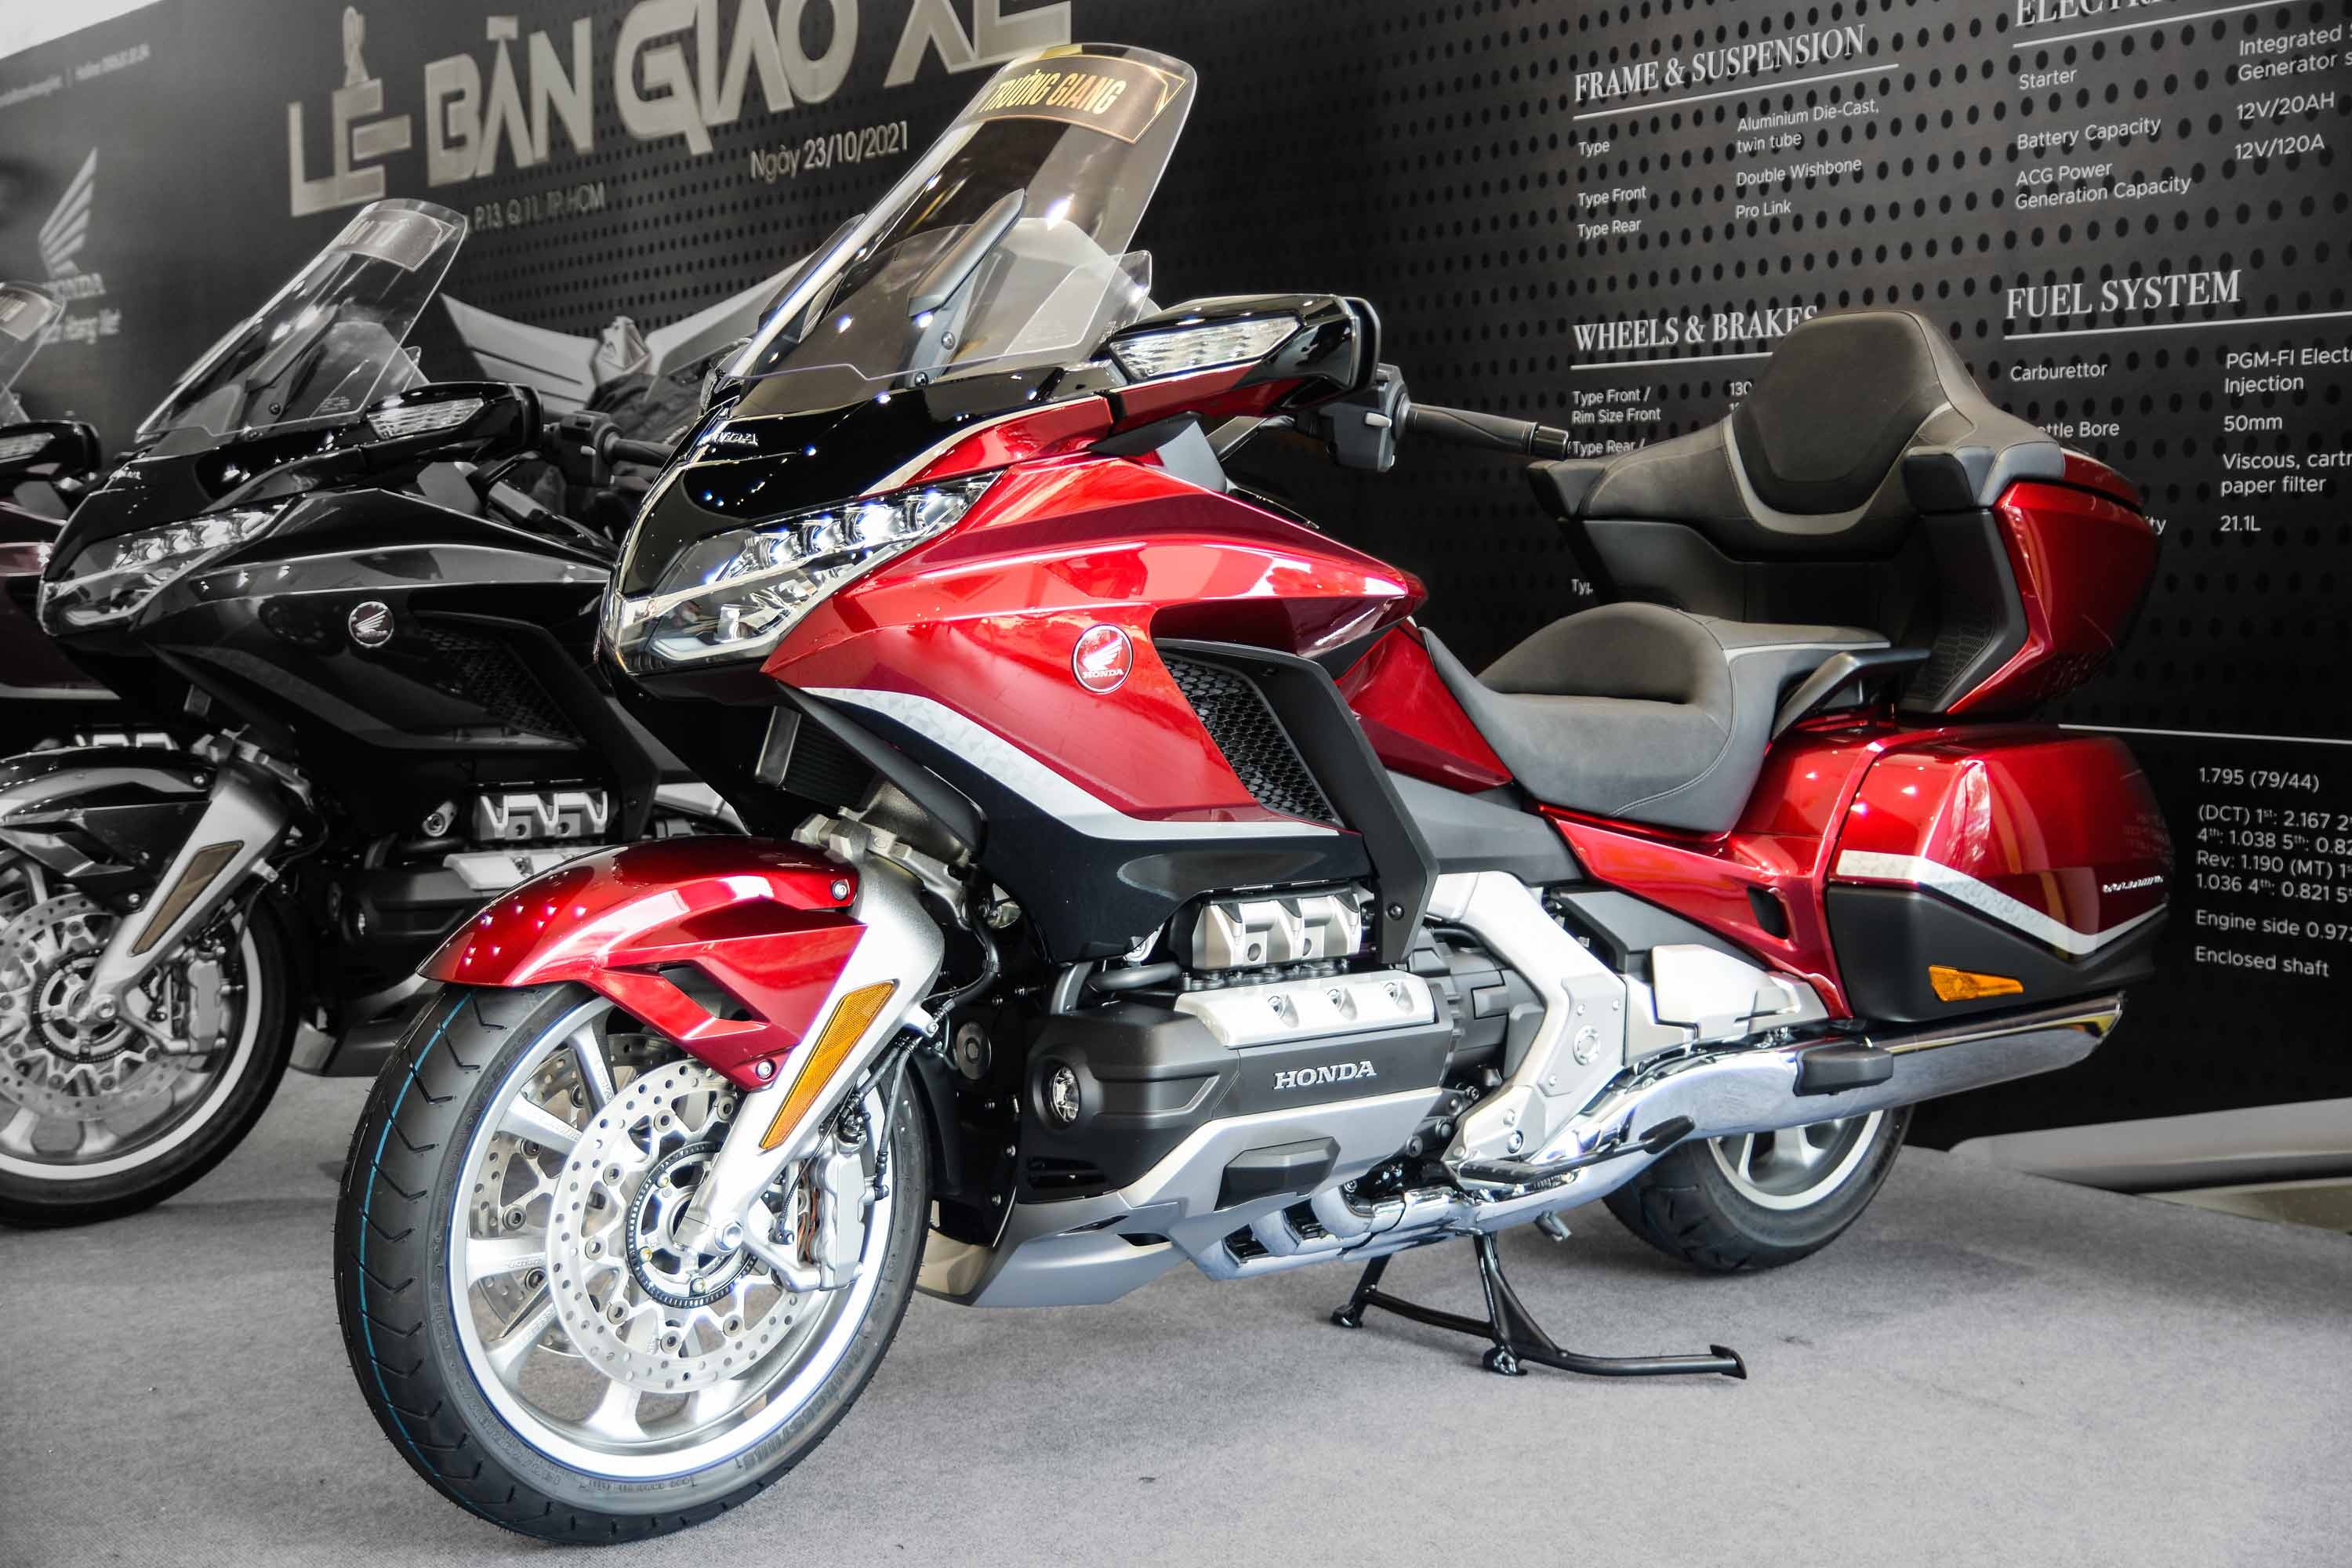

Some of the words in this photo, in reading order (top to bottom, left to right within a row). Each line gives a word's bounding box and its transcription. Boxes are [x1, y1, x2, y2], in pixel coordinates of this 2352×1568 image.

[2239, 24, 2342, 56] Integrated
[1574, 60, 1659, 102] FRAME
[1664, 56, 1686, 86] &
[1692, 24, 1866, 83] SUSPENSION
[2238, 54, 2338, 81] Generator
[2019, 69, 2078, 90] Starter
[1046, 73, 1127, 114] GIANG
[2237, 93, 2336, 121] 12V/20AH
[1737, 111, 1809, 132] Aluminium
[2017, 129, 2079, 150] Battery
[2085, 118, 2161, 140] Capacity
[750, 144, 801, 183] Ngày
[804, 120, 908, 170] 23/10/2021
[1578, 140, 1610, 158] Type
[1737, 138, 1766, 154] twin
[1770, 132, 1802, 148] tube
[2234, 134, 2325, 160] 12V/120A
[1737, 167, 1786, 186] Double
[1790, 158, 1863, 180] Wishbone
[2016, 168, 2053, 187] ACG
[2058, 162, 2113, 183] Power
[1577, 192, 1610, 209] Type
[1611, 185, 1647, 202] Front
[2015, 185, 2109, 210] Generation
[2113, 176, 2192, 199] Capacity
[1736, 205, 1760, 219] Pro
[1763, 198, 1792, 216] Link
[1577, 223, 1609, 240] Type
[1611, 220, 1642, 233] Rear
[2006, 283, 2093, 320] FUEL
[2100, 270, 2241, 313] SYSTEM
[1573, 315, 1679, 351] WHEELS
[1686, 314, 1706, 343] &
[2225, 350, 2295, 370] PGM-FI
[2300, 347, 2352, 366] Elect
[2010, 362, 2108, 382] Carburettor
[1573, 390, 1604, 406] Type
[1606, 389, 1641, 402] Front
[1643, 386, 1650, 401] /
[2224, 375, 2304, 397] Injection
[1572, 411, 1595, 425] Rim
[1598, 408, 1624, 423] Size
[1626, 407, 1661, 422] Front
[2079, 420, 2120, 437] Bore
[2223, 415, 2283, 431] 50mm
[1573, 441, 1604, 456] Type
[1606, 440, 1635, 455] Rear
[2223, 452, 2300, 470] Viscous,
[2220, 478, 2276, 497] paper
[2282, 475, 2327, 492] filter
[2220, 514, 2262, 532] 21.1L
[2199, 768, 2245, 786] 1.795
[2250, 771, 2320, 793] (79/44)
[2198, 804, 2250, 826] (DCT)
[2283, 809, 2331, 829] 2.167
[2229, 829, 2276, 848] 1.038
[2197, 849, 2235, 868] Rev:
[2241, 854, 2284, 873] 1.190
[2290, 858, 2333, 880] (MT)
[2196, 873, 2242, 892] 1.036
[2281, 881, 2329, 902] 0.821
[2196, 909, 2256, 931] Engine
[2263, 917, 2300, 936] side
[2195, 946, 2276, 971] Enclosed
[2283, 956, 2329, 978] shaft
[1272, 1060, 1377, 1091] HONDA
